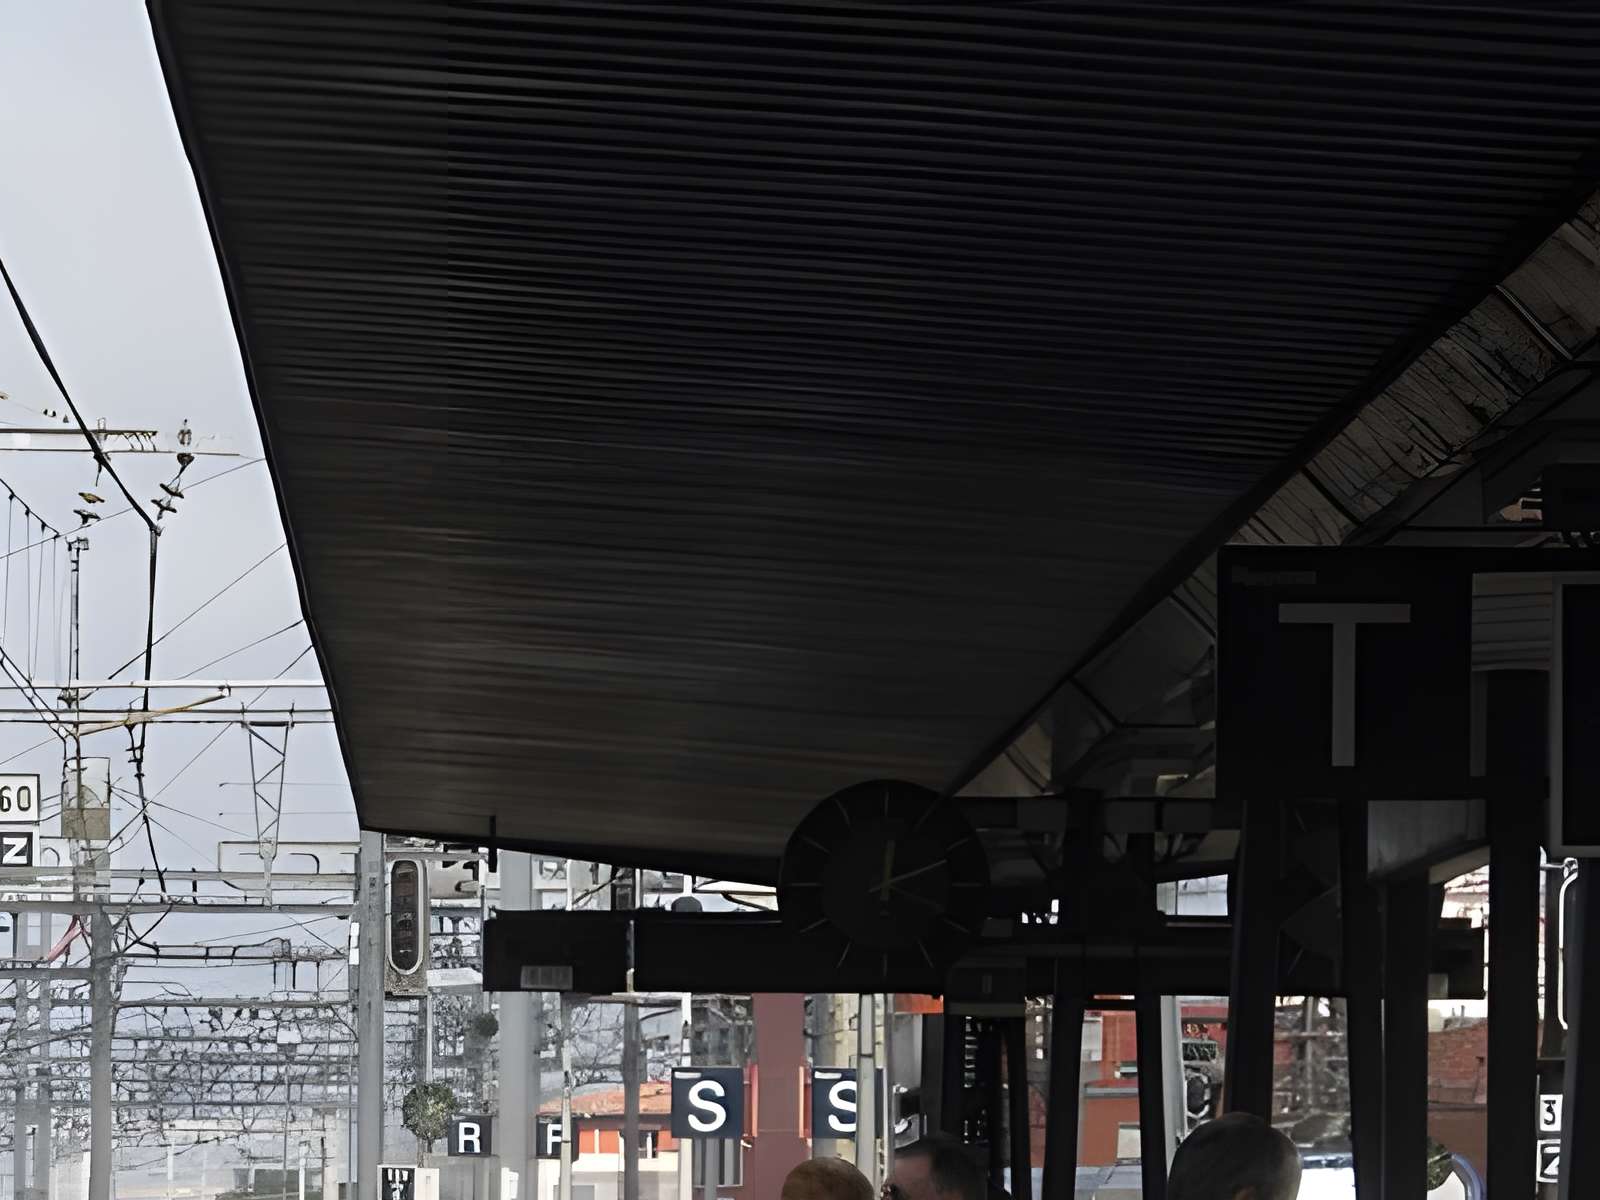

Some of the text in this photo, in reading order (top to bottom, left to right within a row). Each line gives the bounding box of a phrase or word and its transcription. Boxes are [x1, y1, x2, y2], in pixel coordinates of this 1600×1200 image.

[1277, 602, 1412, 767] T
[0, 785, 32, 813] 60
[2, 837, 28, 865] Z
[687, 1079, 728, 1133] S
[828, 1079, 857, 1133] S
[457, 1121, 482, 1154] R
